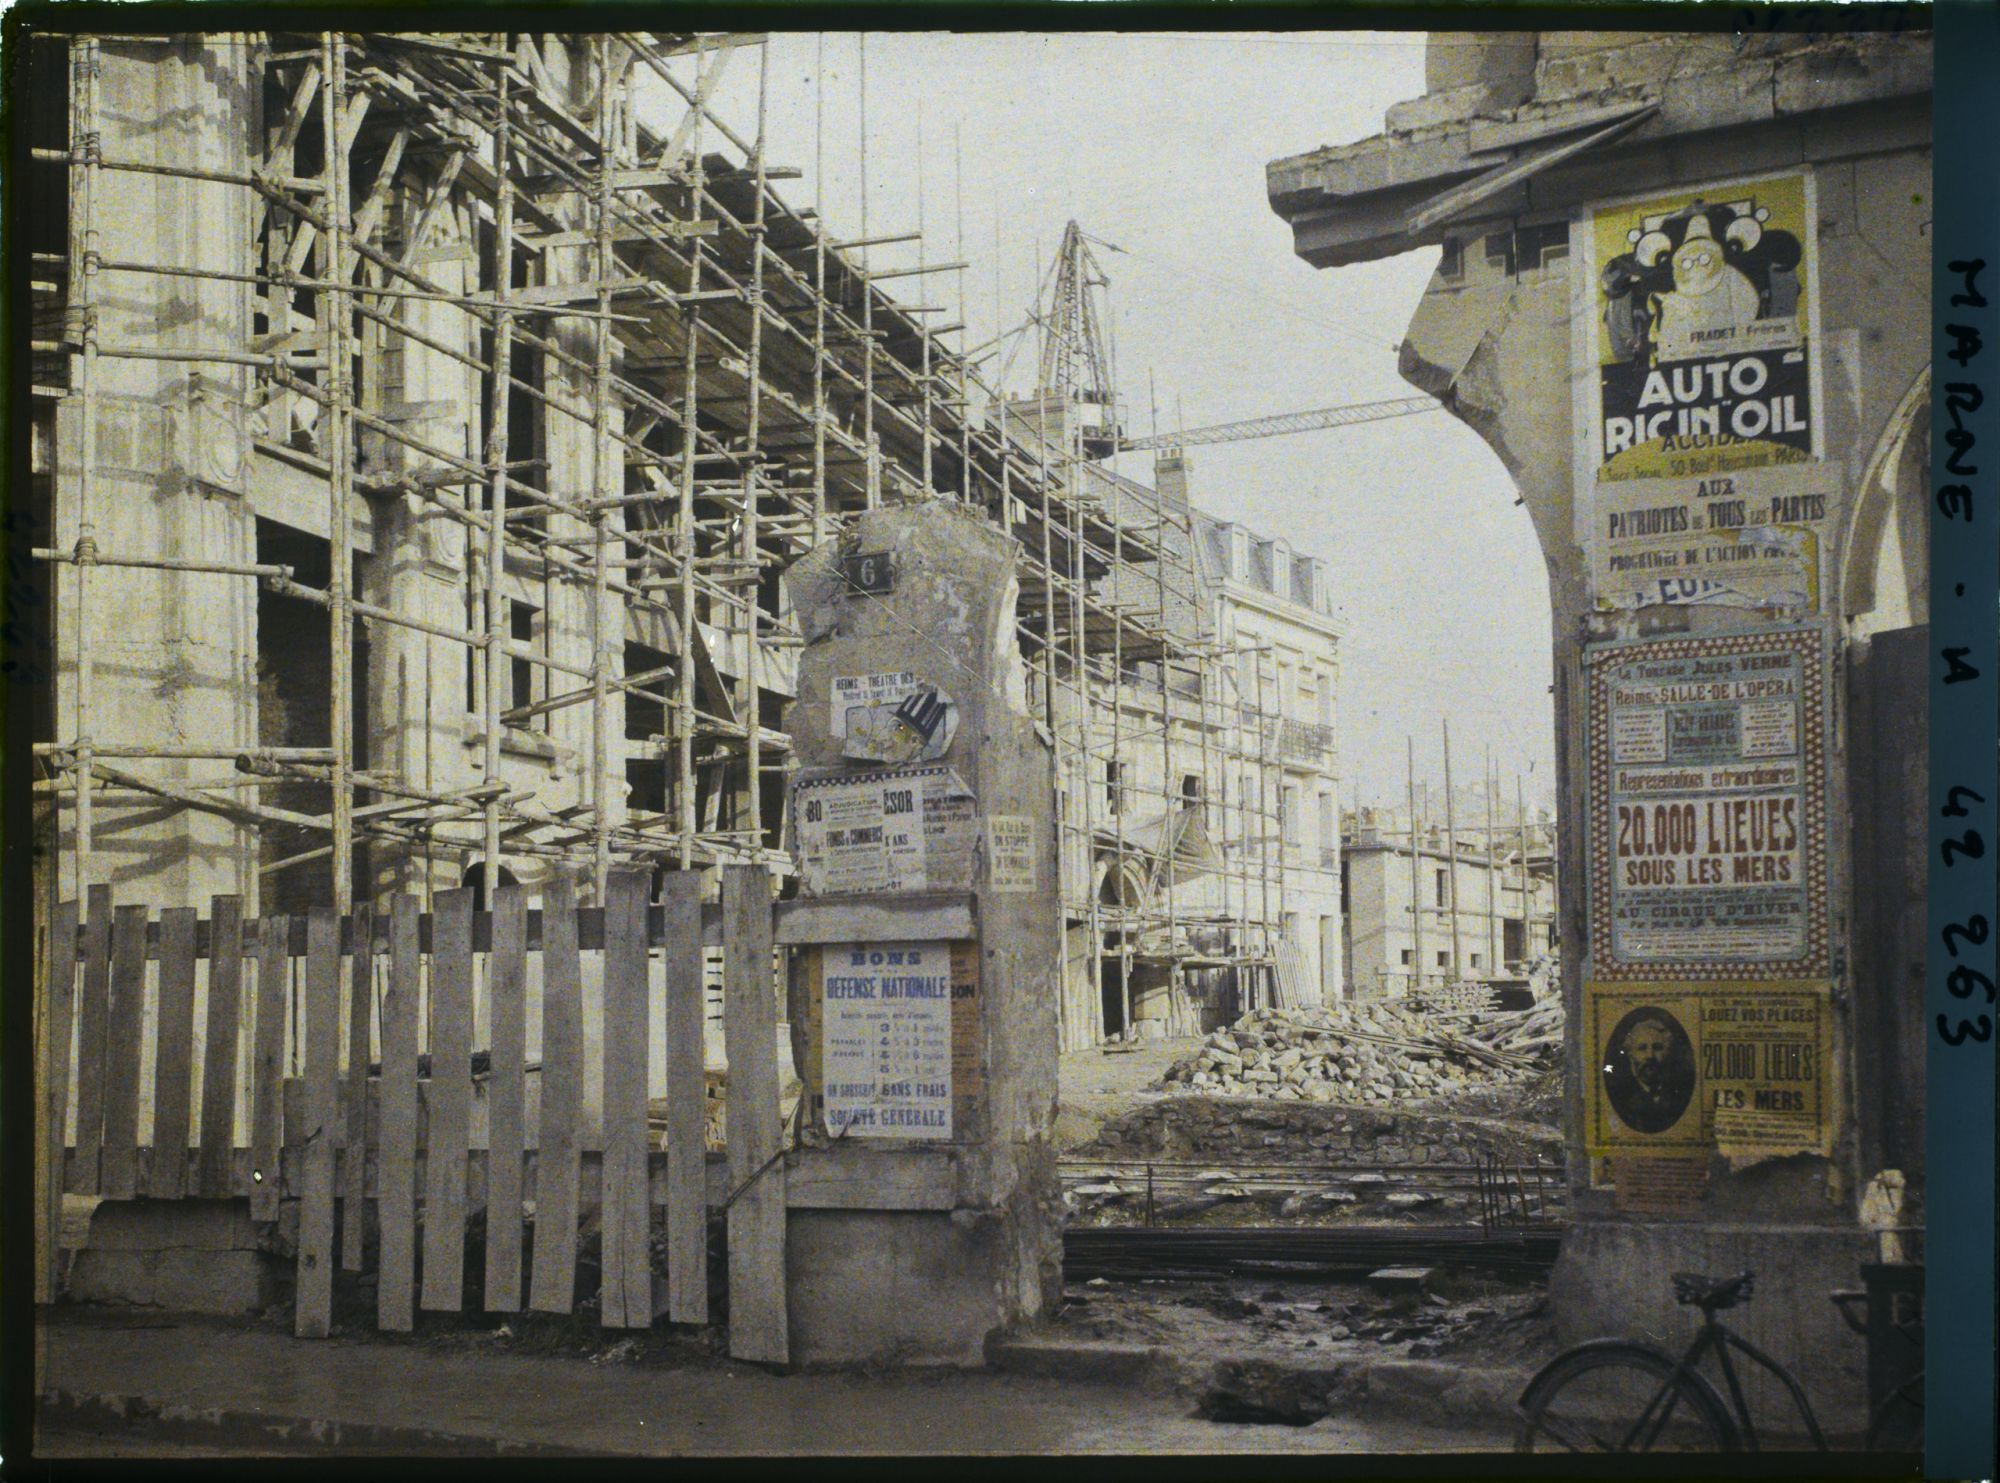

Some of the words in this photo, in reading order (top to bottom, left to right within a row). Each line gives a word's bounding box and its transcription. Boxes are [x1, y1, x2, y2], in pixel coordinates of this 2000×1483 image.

[1637, 357, 1768, 409] AUTO
[1605, 404, 1720, 454] RICIN
[1731, 395, 1806, 437] OIL
[1697, 478, 1735, 497] AUX
[1609, 505, 1688, 539] PATRIOTES
[1708, 500, 1746, 528] TOUS
[1771, 494, 1826, 523] PARTIS
[860, 559, 876, 586] 6
[1740, 654, 1792, 671] VERNE
[1660, 684, 1705, 703] SALLE
[1712, 683, 1730, 700] DE
[1618, 803, 1697, 857] 20.000
[1707, 798, 1797, 854] LIEUES
[1627, 859, 1676, 886] SOUS
[1687, 858, 1722, 885] LES
[1733, 855, 1791, 883] MERS
[1616, 905, 1640, 919] AU
[1651, 904, 1717, 918] CIRQUE
[1727, 902, 1801, 916] D'HIVER
[851, 951, 921, 966] BONS
[881, 976, 947, 999] NATIONALE
[1702, 1008, 1737, 1022] LOUEZ
[1742, 1008, 1765, 1022] VOS
[1768, 1008, 1814, 1023] PLACES
[1703, 1043, 1756, 1080] 20.000
[1764, 1043, 1813, 1081] LIEUES
[881, 1083, 911, 1096] SANS
[917, 1083, 947, 1097] FRAIS
[1713, 1090, 1744, 1109] LES
[1755, 1090, 1804, 1111] MERS
